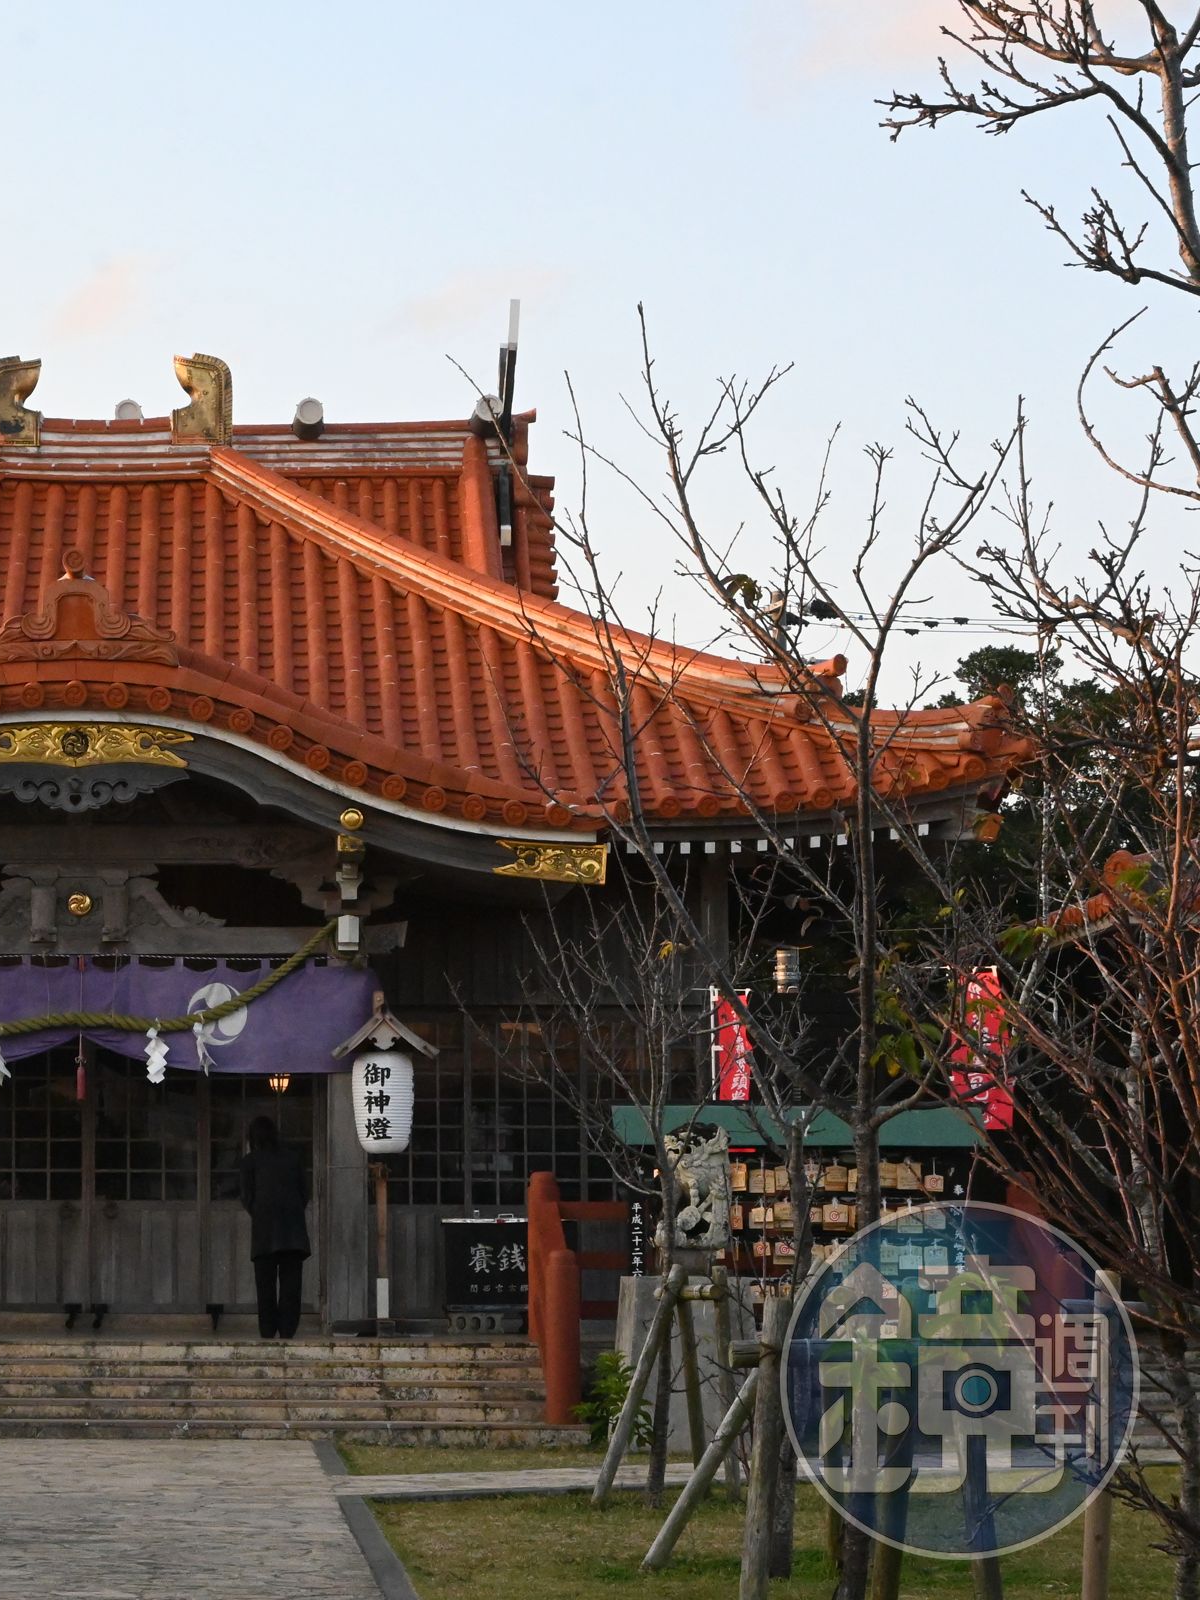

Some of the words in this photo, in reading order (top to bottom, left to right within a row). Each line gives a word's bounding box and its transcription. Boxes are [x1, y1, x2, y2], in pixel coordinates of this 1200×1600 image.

[362, 1062, 393, 1141] 御神燈
[468, 1242, 527, 1274] 賽銭
[631, 1202, 643, 1278] 平成二十二年六
